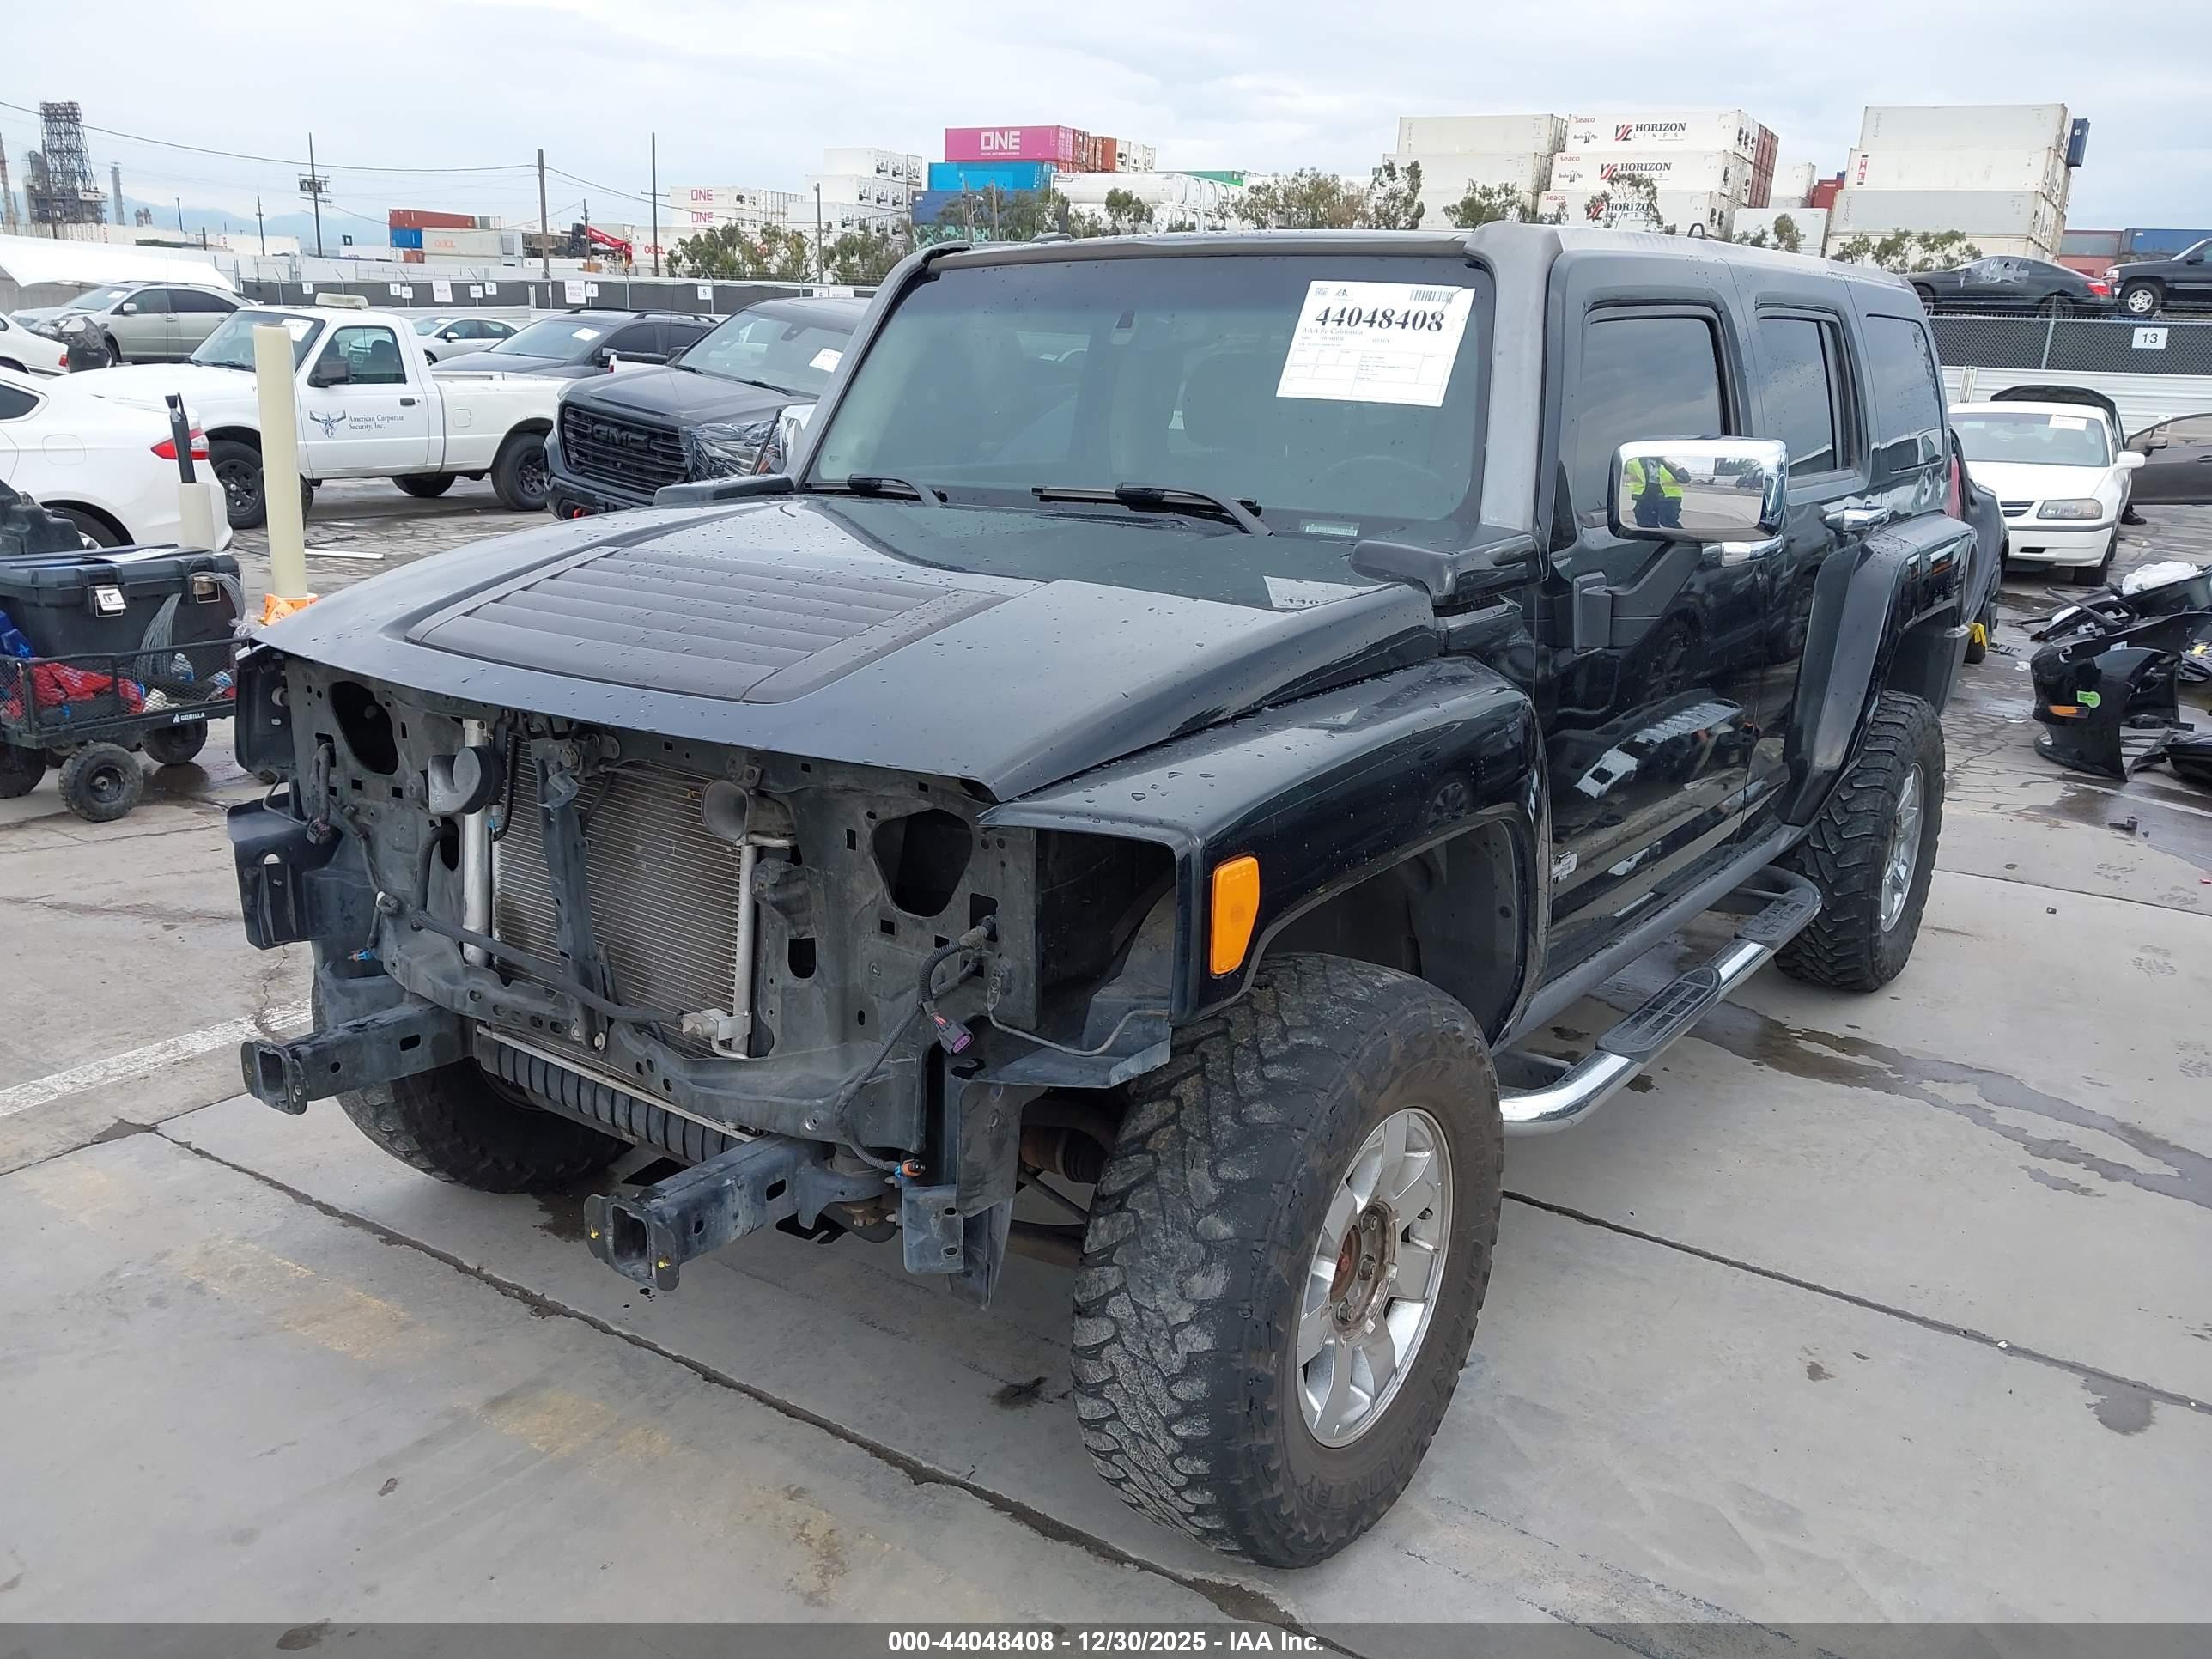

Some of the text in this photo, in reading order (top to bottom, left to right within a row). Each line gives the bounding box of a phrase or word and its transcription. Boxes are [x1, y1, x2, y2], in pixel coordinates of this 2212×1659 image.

[1635, 122, 1687, 132] HORIZON
[981, 131, 1021, 150] ONE
[1620, 162, 1673, 172] HORIZON
[690, 189, 714, 201] ONE
[691, 212, 714, 223] ONE
[1315, 306, 1445, 332] 44048408
[1330, 327, 1364, 336] California
[2142, 332, 2158, 343] 13
[592, 424, 648, 448] GMC
[180, 712, 205, 721] GORILLA
